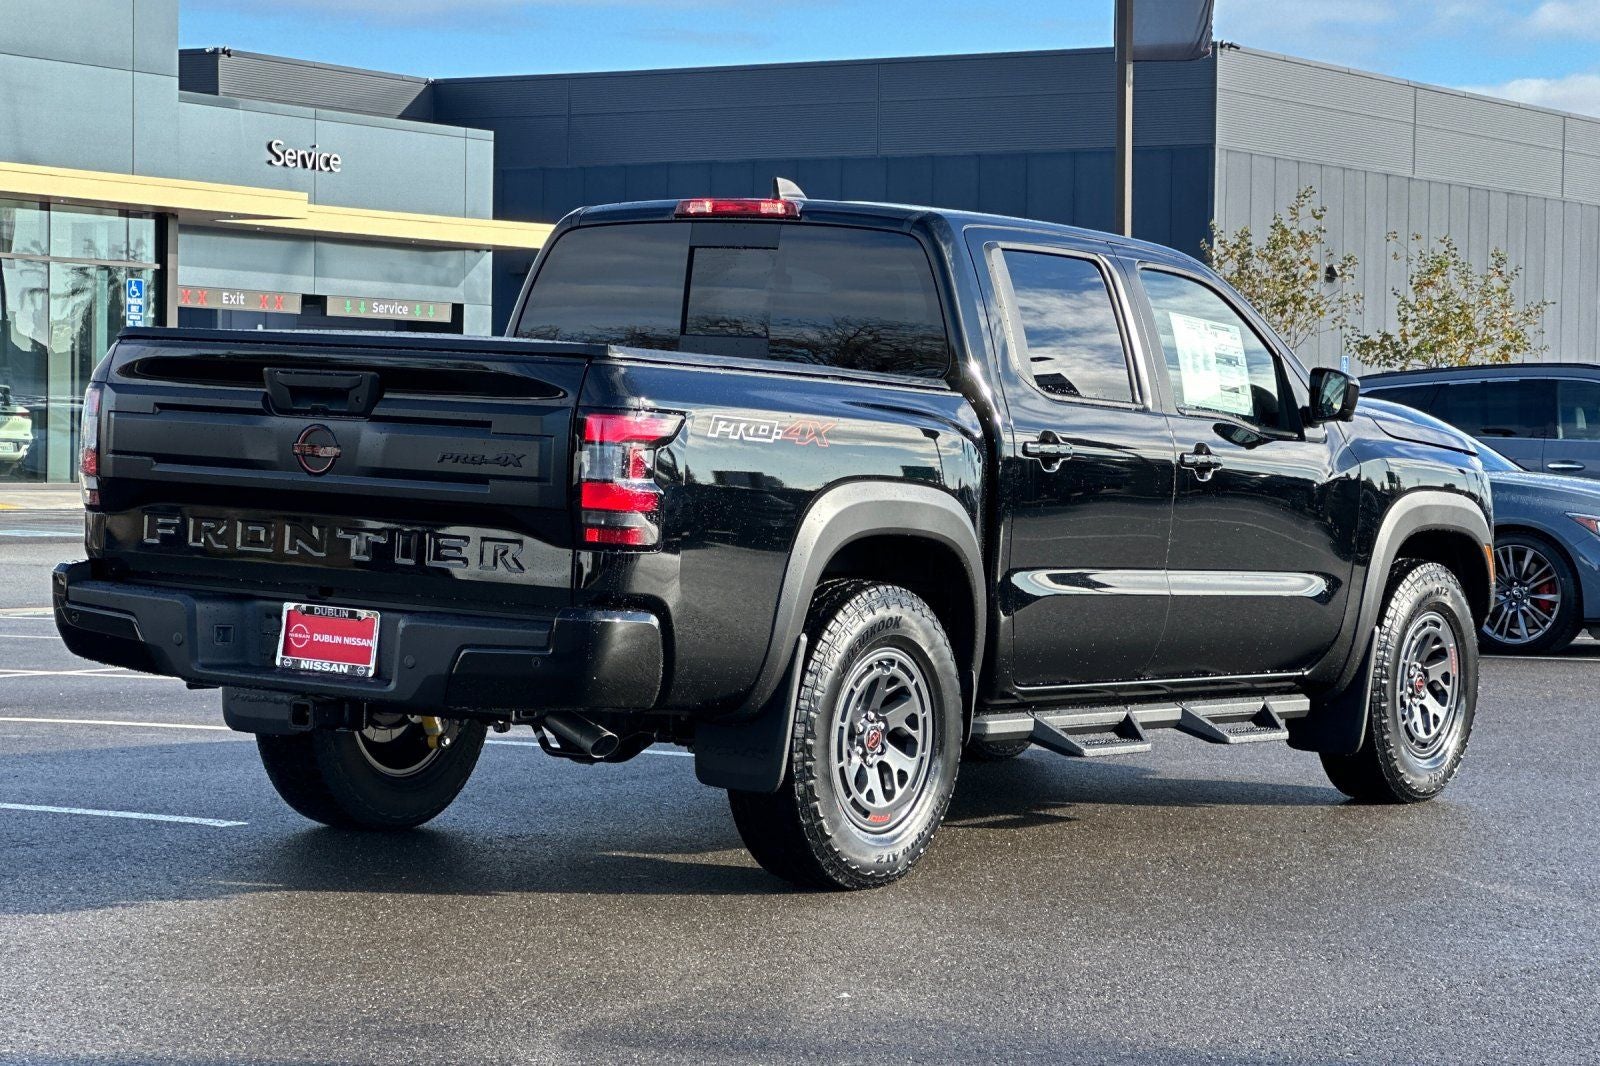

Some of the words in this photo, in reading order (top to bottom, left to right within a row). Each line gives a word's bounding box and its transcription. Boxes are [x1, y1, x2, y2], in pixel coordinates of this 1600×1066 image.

[269, 139, 342, 173] Service
[222, 292, 245, 305] Exit
[372, 302, 409, 315] Service
[143, 513, 526, 574] FRONTIER
[313, 607, 349, 618] DUBLIN
[313, 633, 343, 644] DUBLIN
[343, 636, 373, 648] NISSAN
[300, 660, 349, 674] NISSAN
